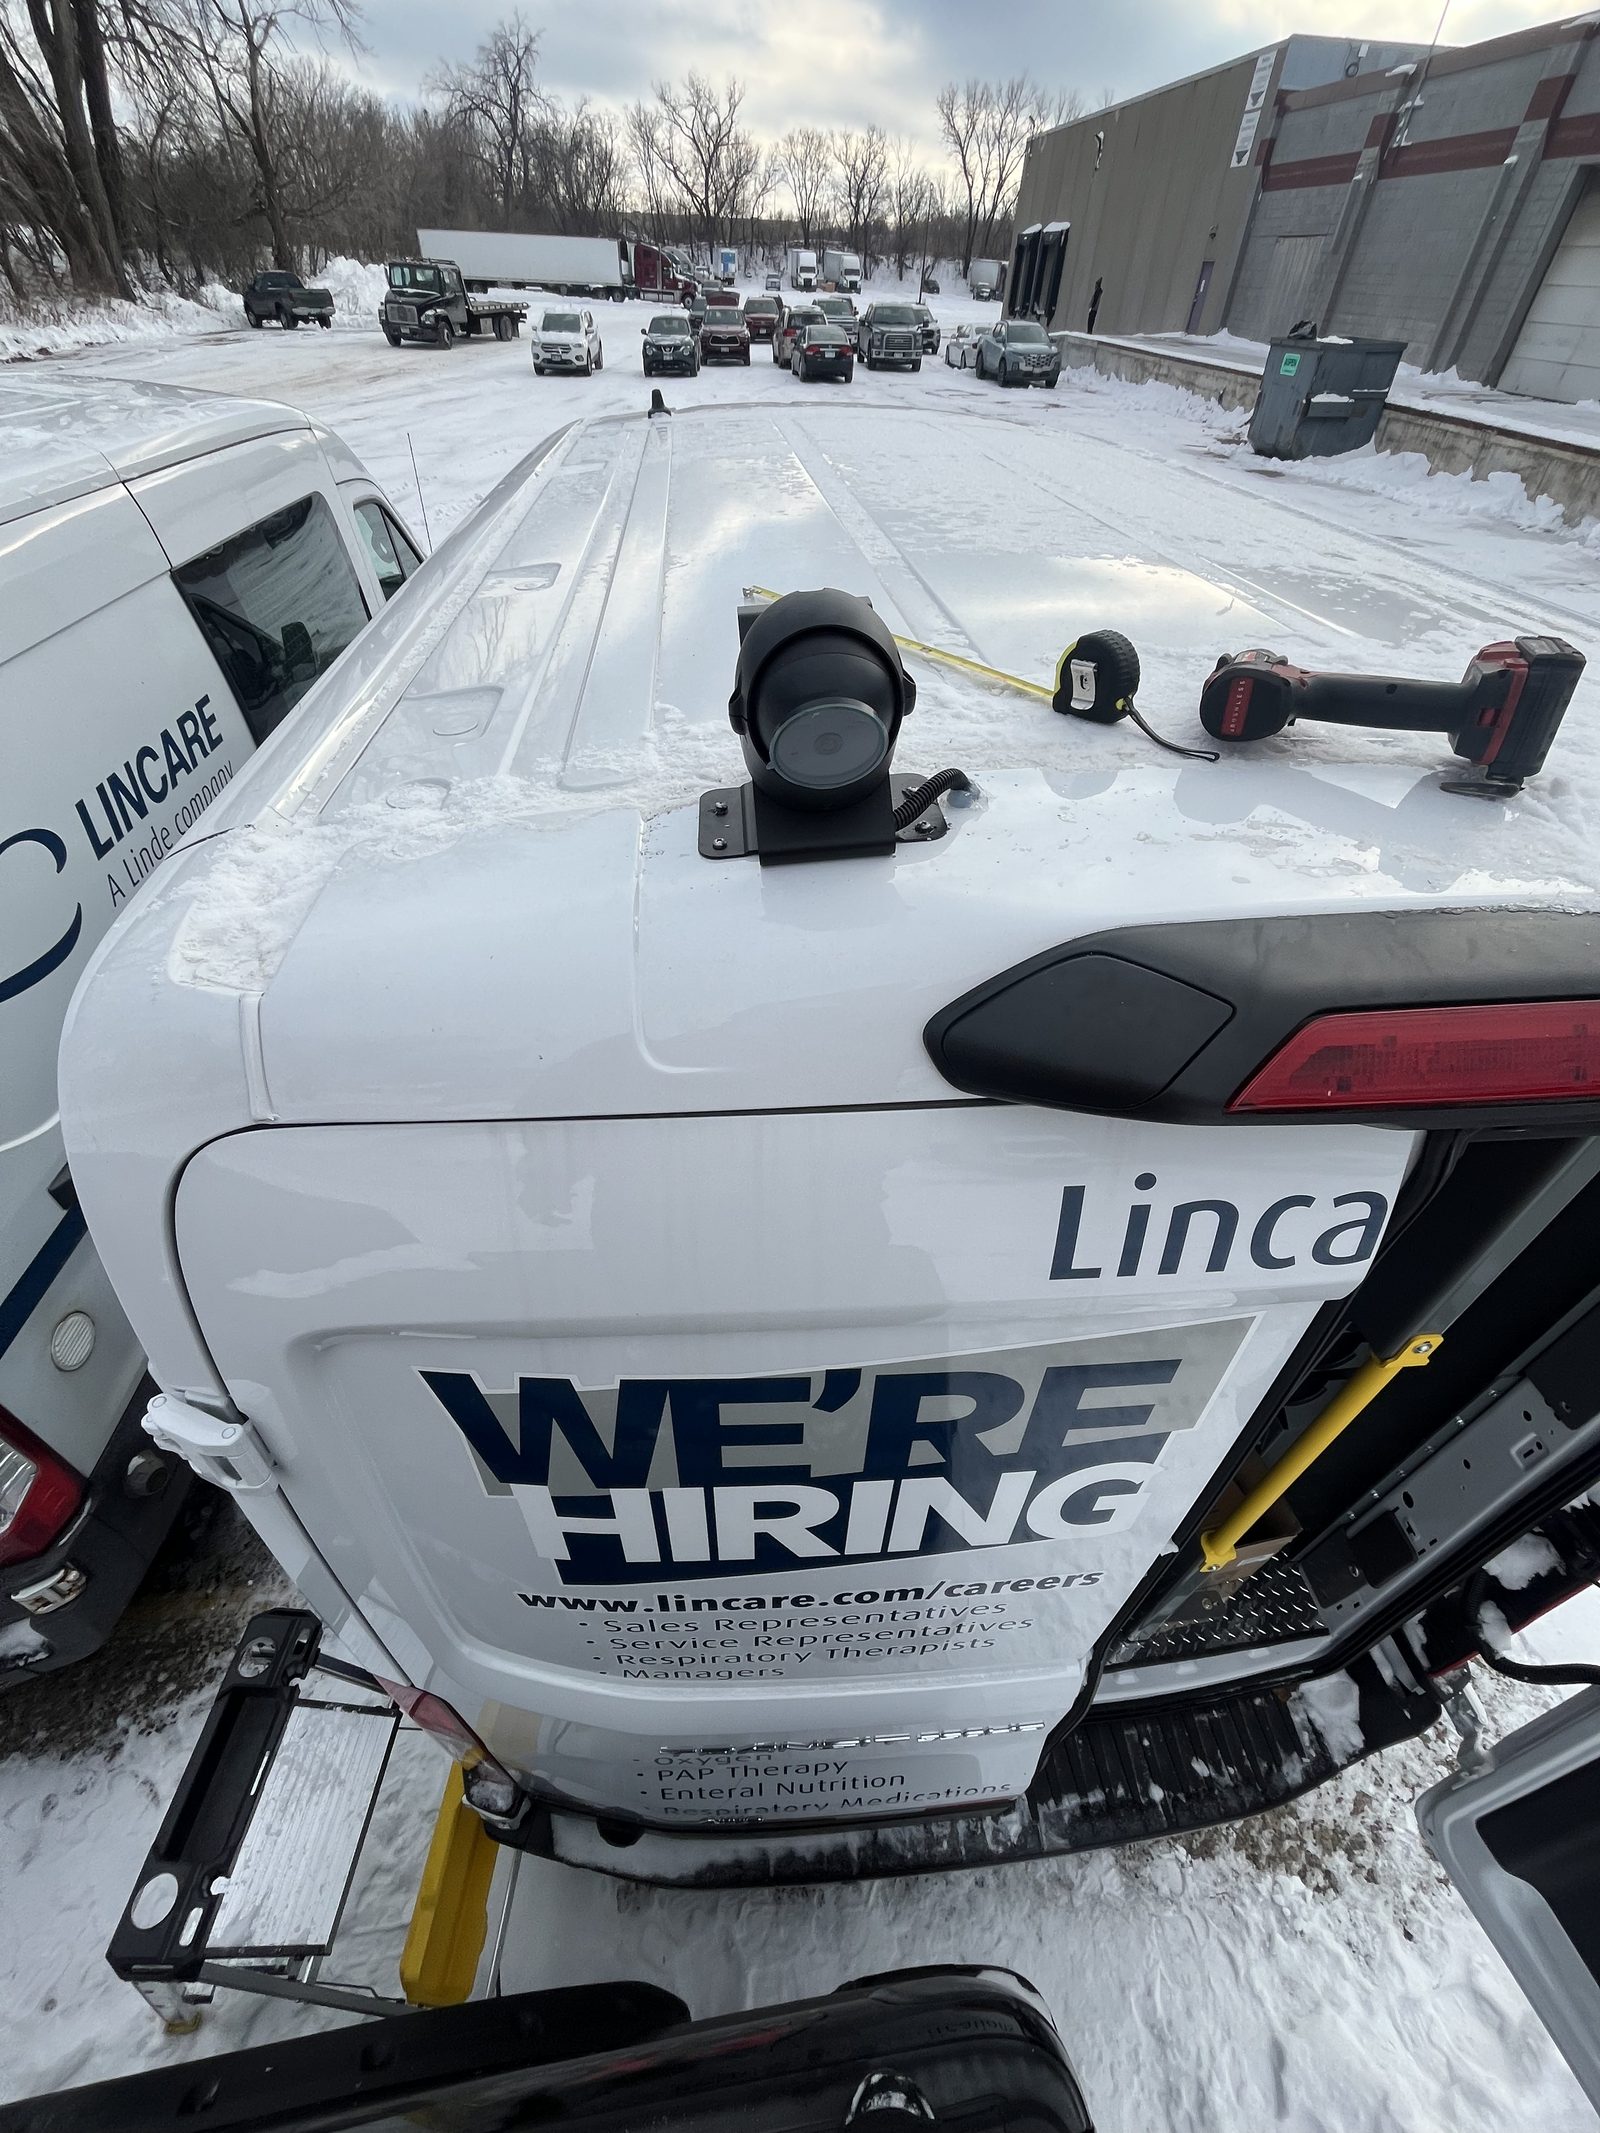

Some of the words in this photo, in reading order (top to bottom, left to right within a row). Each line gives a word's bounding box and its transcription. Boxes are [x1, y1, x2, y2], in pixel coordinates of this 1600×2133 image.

[75, 694, 223, 861] LINCARE
[107, 873, 126, 907] A
[122, 826, 174, 887] Linde
[174, 760, 235, 835] company
[1049, 1172, 1389, 1280] Linca
[418, 1358, 1183, 1488] WE'RE
[511, 1460, 1158, 1562] HIRING
[517, 1571, 1104, 1613] www.lincare.com/careers
[603, 1619, 699, 1633] Sales
[714, 1603, 1007, 1632] Representatives
[609, 1637, 739, 1650] Service
[754, 1618, 1034, 1647] Representatives
[616, 1650, 812, 1667] Respiratory
[826, 1637, 996, 1660] Therapists
[623, 1668, 784, 1680] Managers
[658, 1768, 714, 1781] PAP
[726, 1761, 848, 1778] Therapy
[661, 1782, 763, 1801] Enteral
[777, 1775, 905, 1796] Nutrition
[664, 1803, 829, 1817] Respiratory
